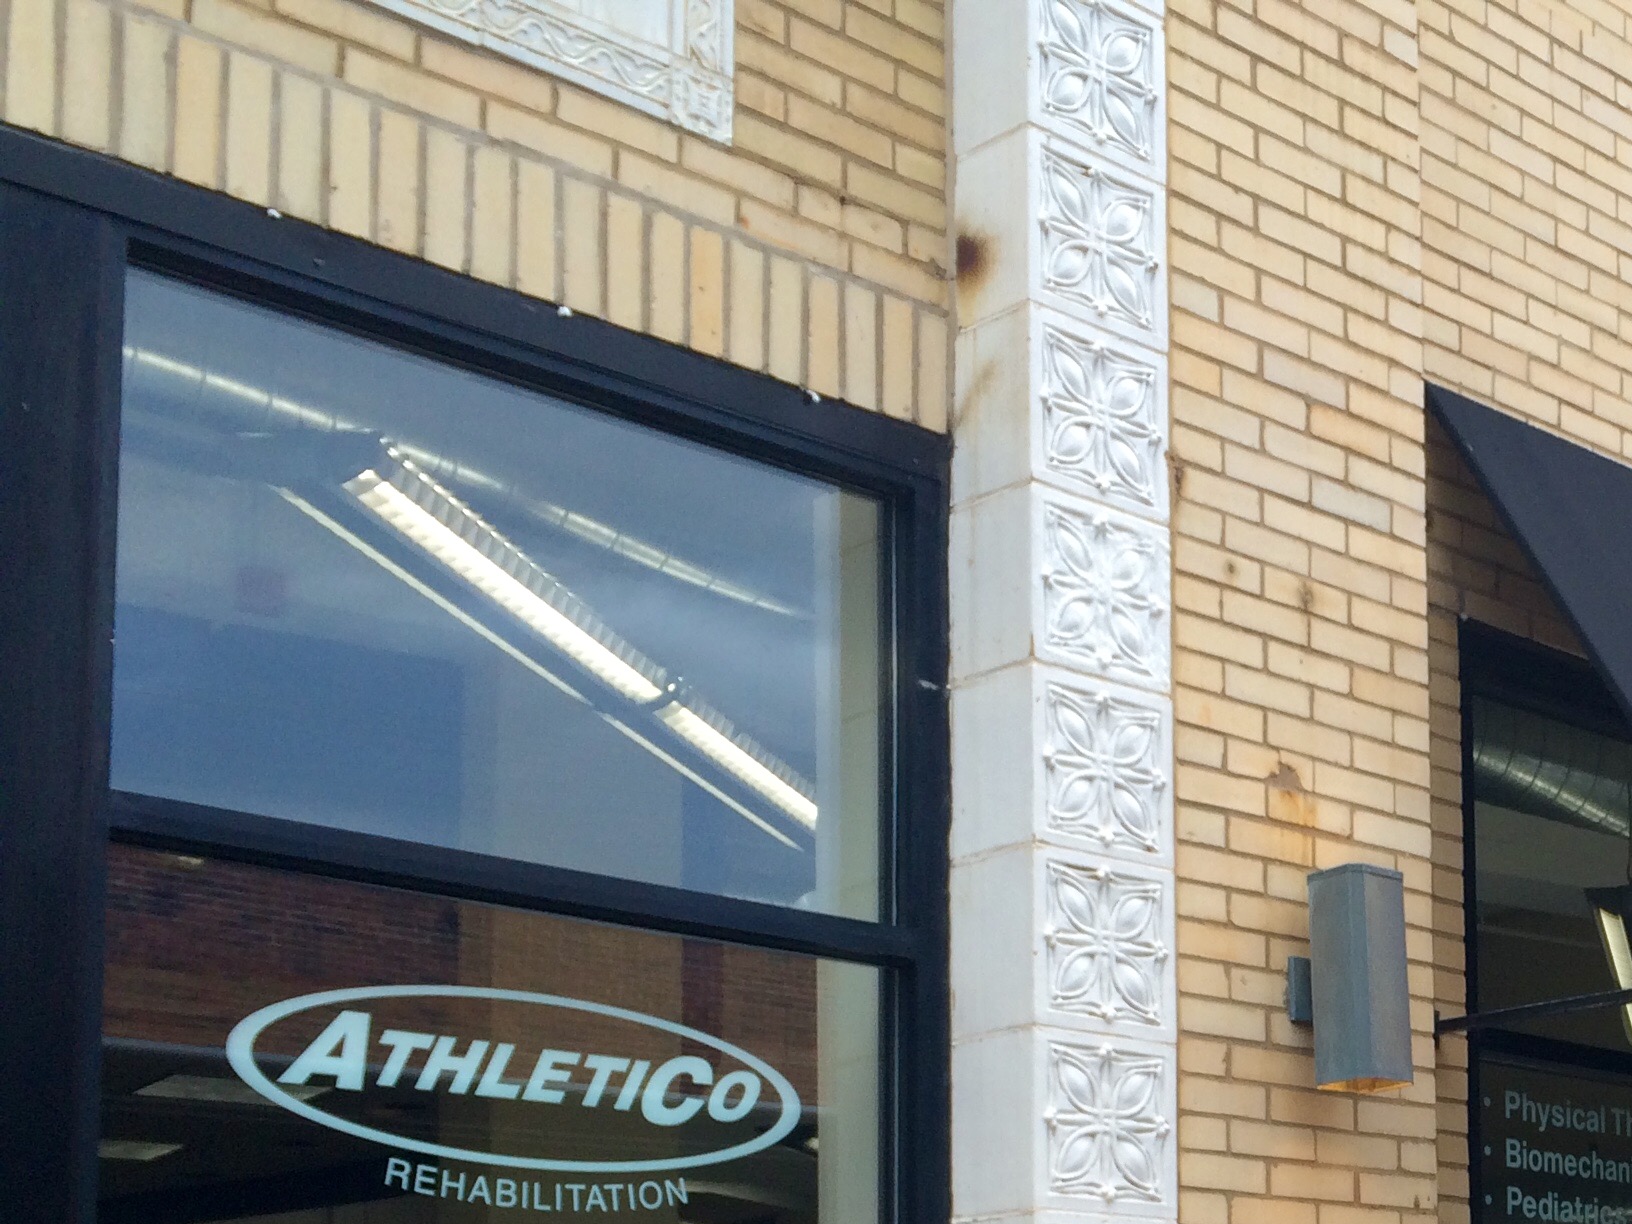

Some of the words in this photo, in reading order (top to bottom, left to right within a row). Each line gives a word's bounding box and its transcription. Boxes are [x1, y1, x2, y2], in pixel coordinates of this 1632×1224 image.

[277, 1011, 761, 1126] ATHLETICO
[1505, 1090, 1606, 1134] Physical
[384, 1157, 689, 1212] REHABILITATION
